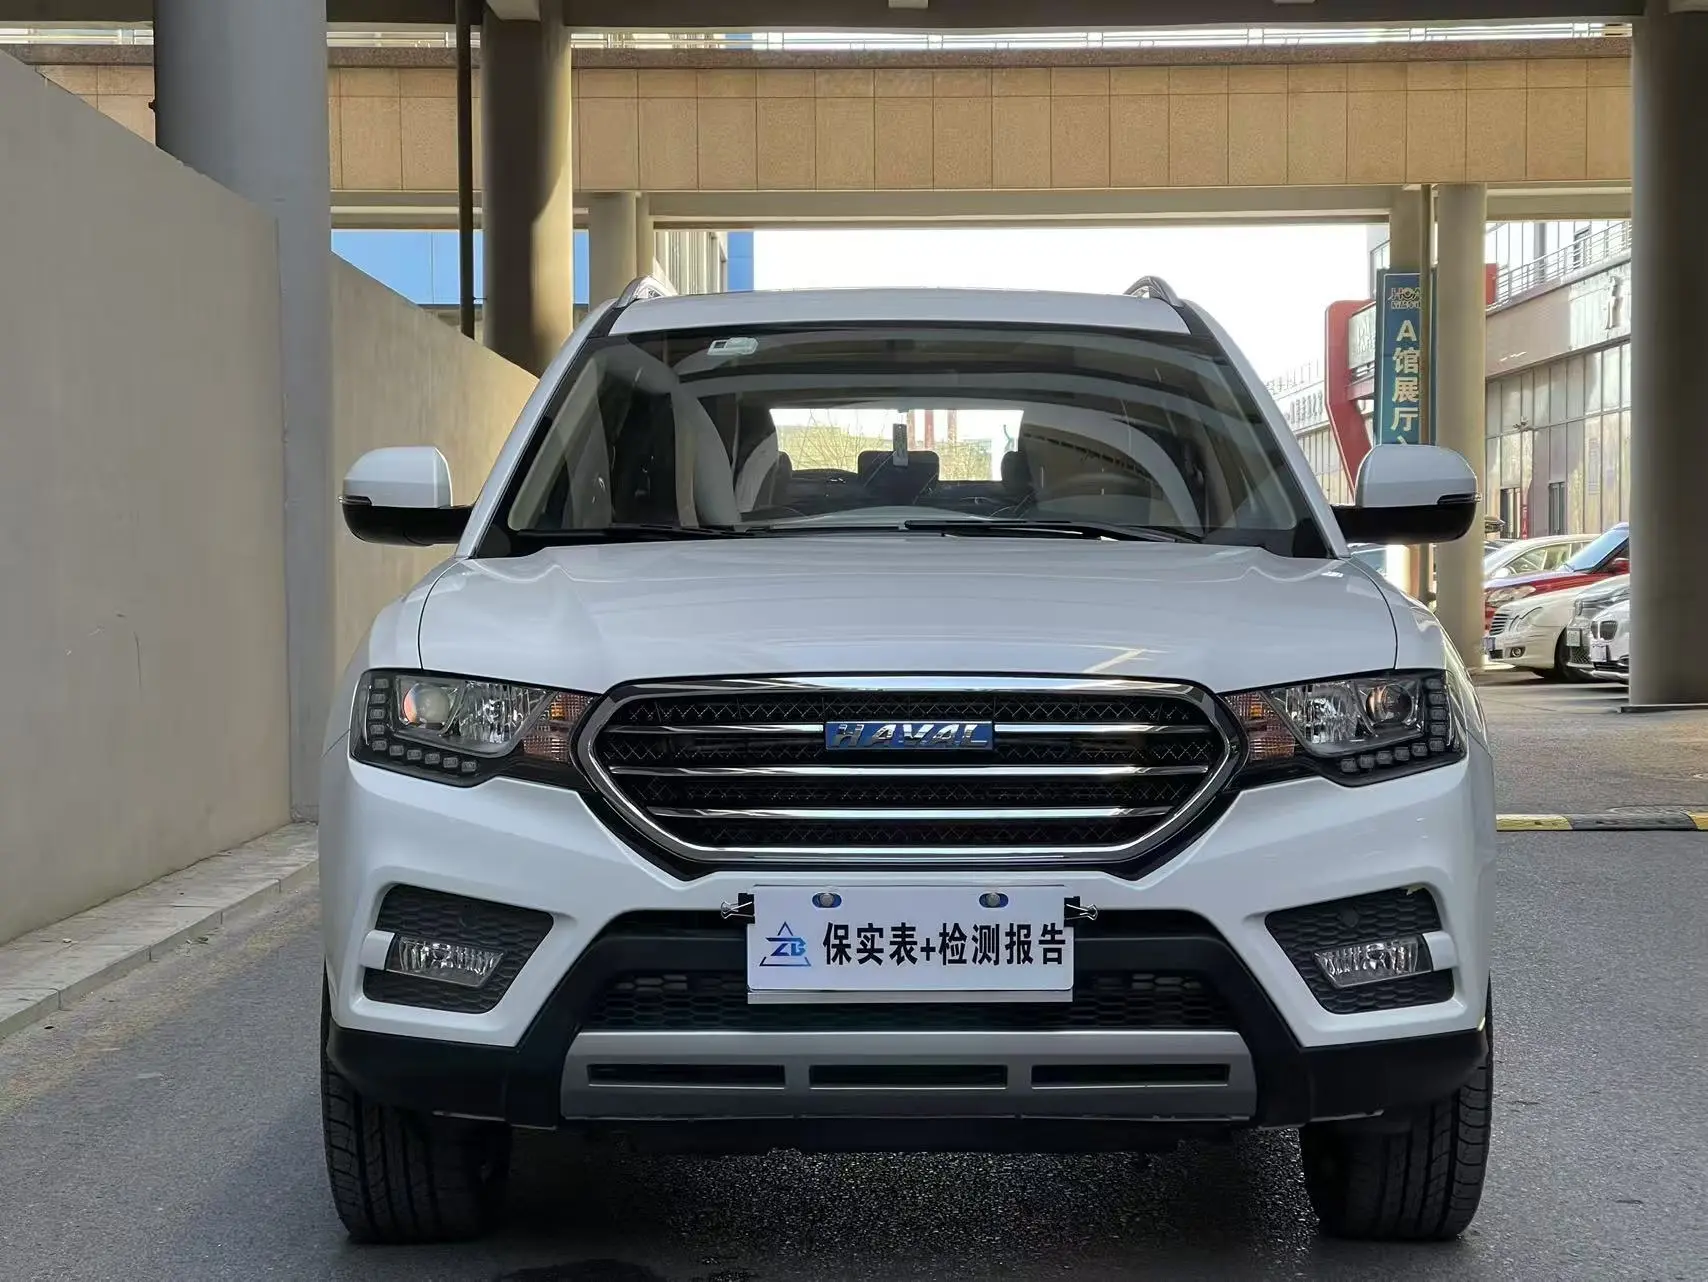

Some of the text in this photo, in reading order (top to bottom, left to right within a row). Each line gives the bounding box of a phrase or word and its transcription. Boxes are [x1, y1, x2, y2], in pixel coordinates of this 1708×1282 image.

[830, 723, 988, 748] HAVAL
[822, 921, 1067, 966] 保实表+检测报告
